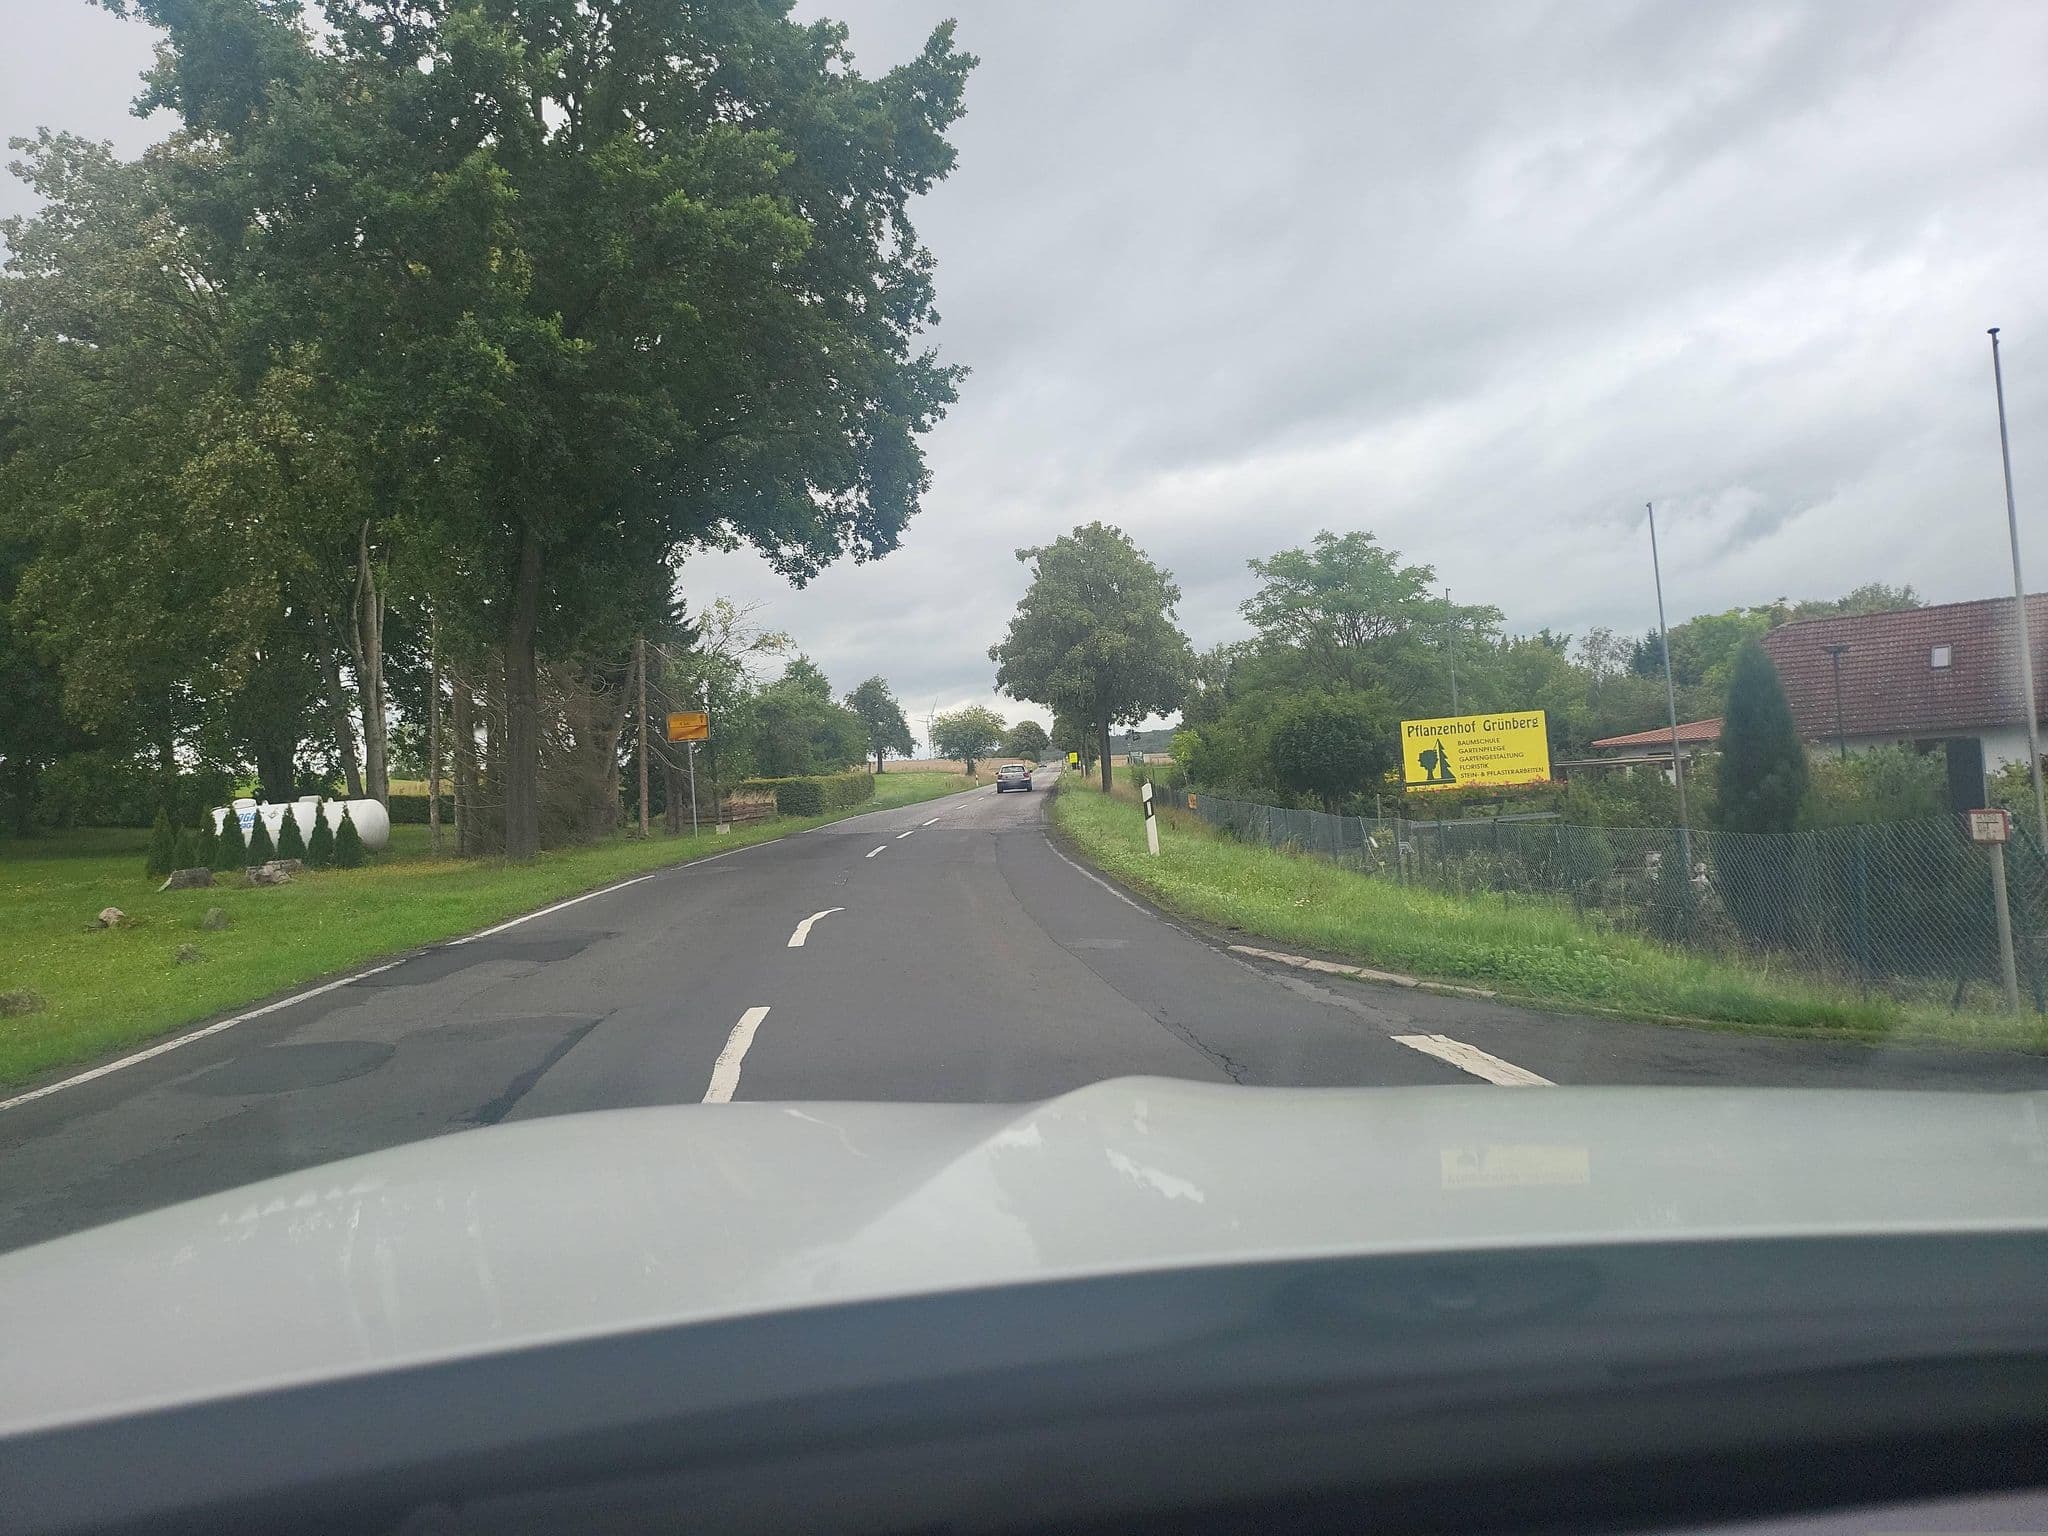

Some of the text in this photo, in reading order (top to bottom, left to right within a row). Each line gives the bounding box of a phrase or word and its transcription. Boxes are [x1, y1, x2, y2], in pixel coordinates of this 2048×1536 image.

[1407, 718, 1539, 737] Pflanzenhof Grünberg
[1458, 738, 1500, 746] BAUMSCHULE
[1458, 746, 1505, 754] GARTENPFLEGE
[1459, 752, 1524, 762] GARTENGESTALTUNG
[1459, 763, 1489, 771] FLORISTIK
[1460, 771, 1480, 779] STEIN-
[1486, 767, 1544, 776] PFLASTERARBEITEN
